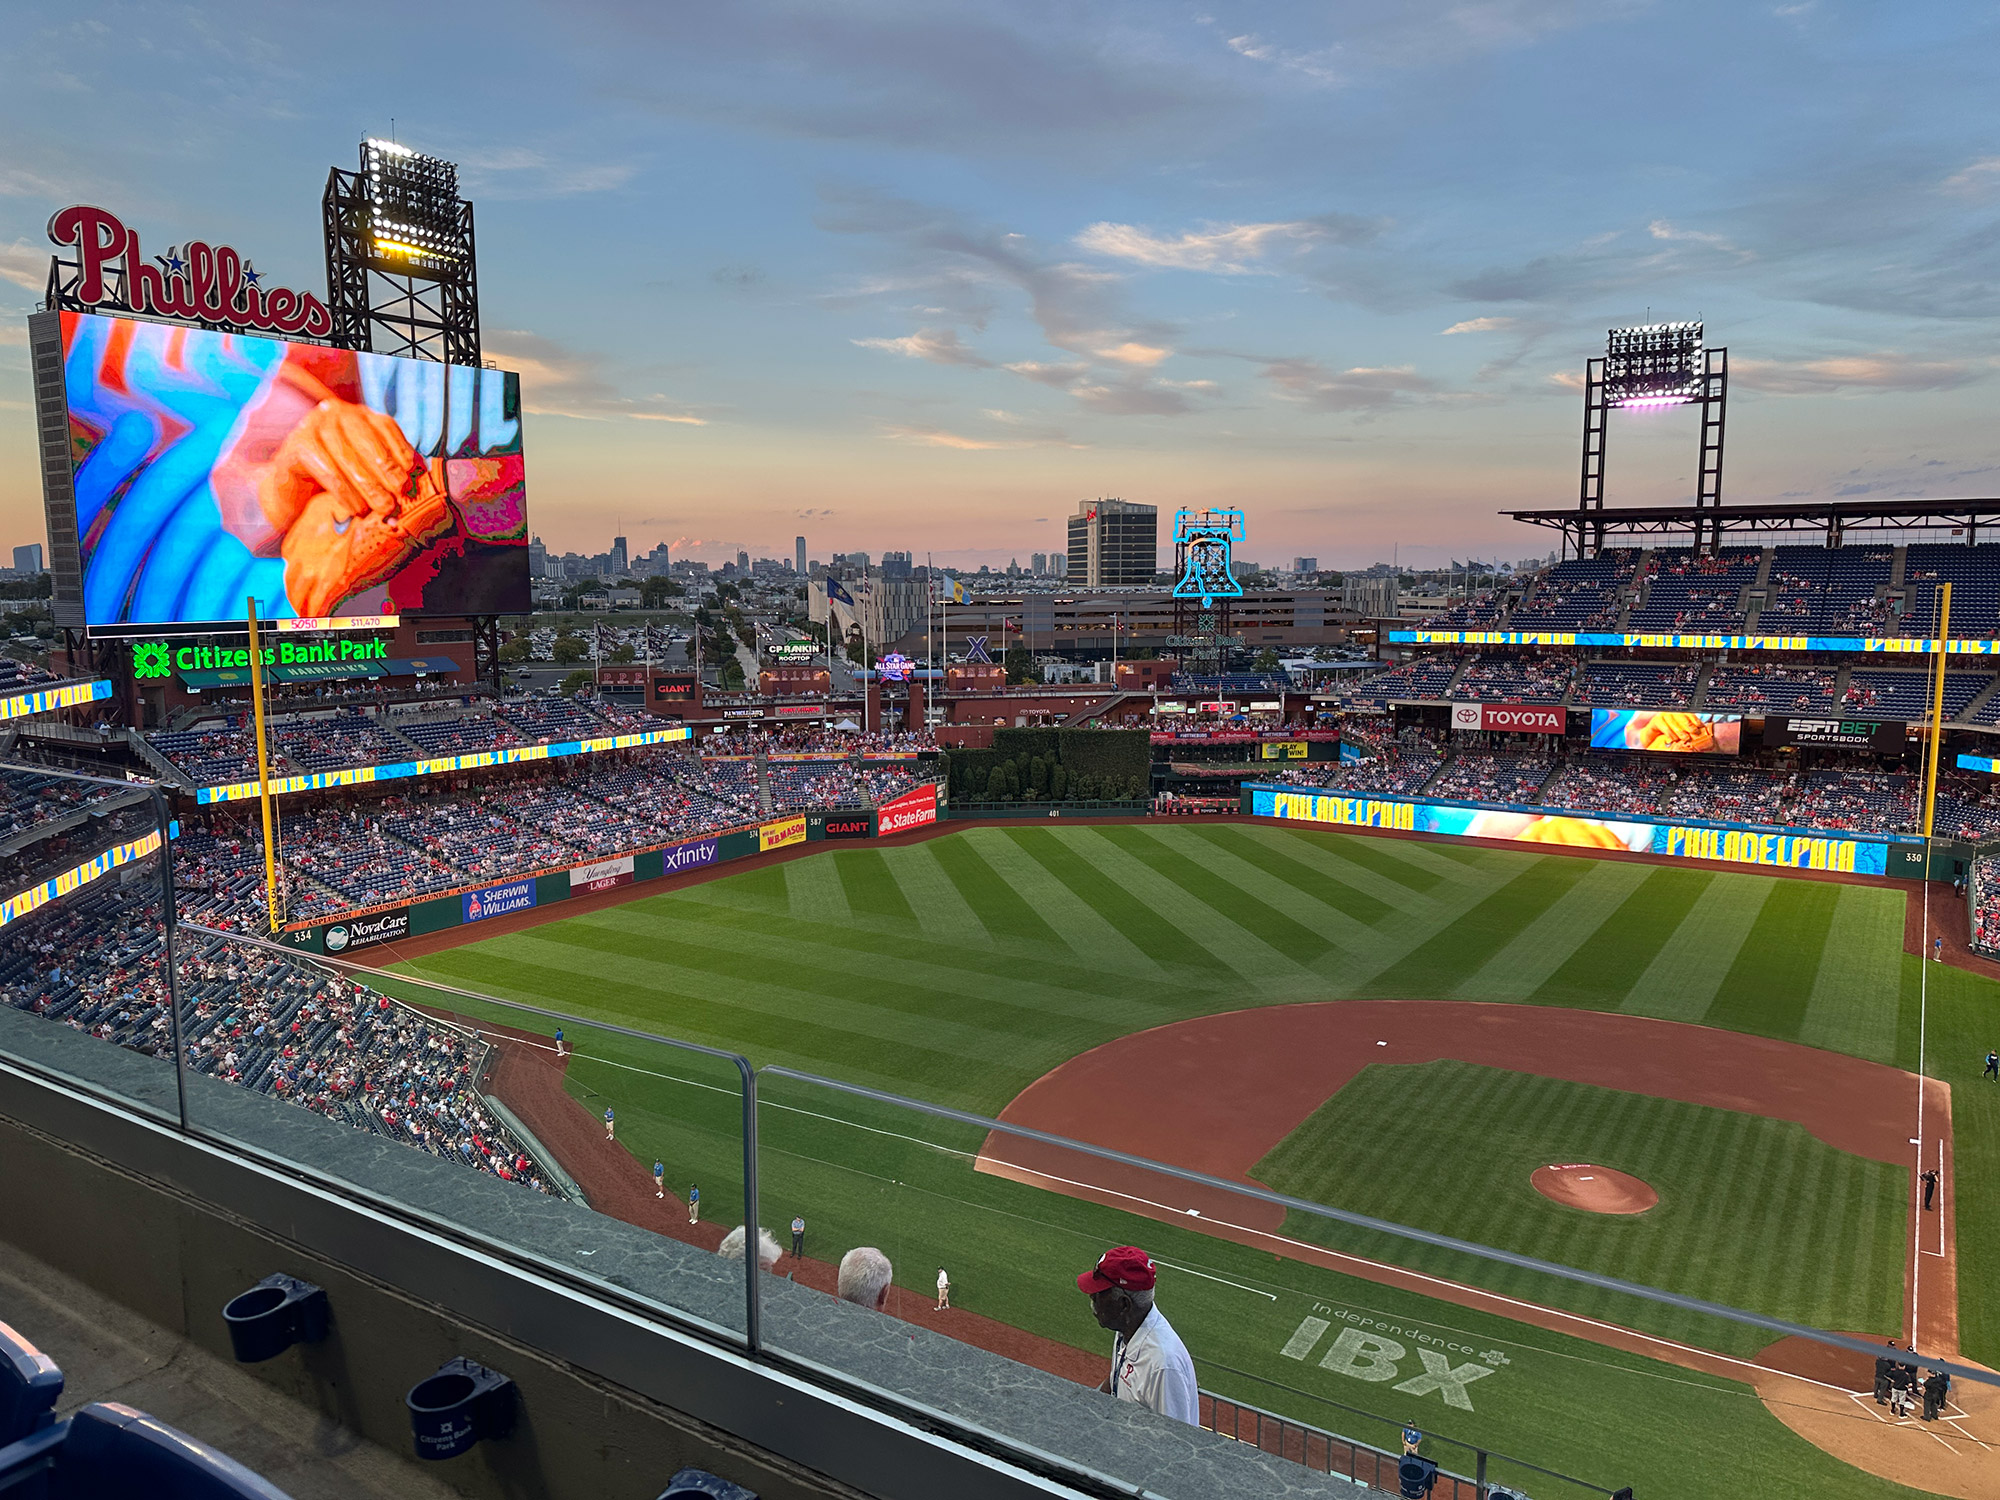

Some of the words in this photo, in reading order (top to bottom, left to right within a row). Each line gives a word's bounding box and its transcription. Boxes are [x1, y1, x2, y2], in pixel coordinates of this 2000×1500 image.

[48, 204, 332, 337] Phillies
[1165, 634, 1214, 647] Citizens
[1215, 634, 1246, 646] Bank
[176, 645, 276, 670] Citizens
[280, 639, 337, 664] Bank
[340, 637, 387, 660] Park
[768, 645, 783, 653] CP
[1192, 647, 1220, 659] Park
[287, 666, 331, 676] HARRY
[658, 684, 691, 693] GIANT
[1486, 710, 1559, 727] TOYOTA
[1787, 719, 1840, 733] ESPN
[1840, 721, 1881, 735] BET
[1796, 733, 1869, 743] SPORTSBOOK
[1274, 793, 1414, 830] PHILADELPHIA
[810, 818, 822, 826] 387
[826, 822, 869, 833] GIANT
[666, 843, 716, 869] xfinity
[1666, 826, 1856, 873] PHILADELPHIA
[1906, 852, 1922, 862] 330
[500, 871, 537, 885] ASPLUNDH
[590, 878, 616, 891] LAGER
[456, 880, 494, 894] ASPLUNDH
[483, 884, 529, 903] SHERWIN
[409, 890, 450, 904] ASPLUNDH
[360, 901, 402, 916] ASPLUNDH
[307, 912, 352, 928] ASPLUNDH
[350, 914, 408, 938] NovaCare
[294, 930, 312, 943] 334
[351, 928, 406, 946] REHABILITATION
[1312, 1302, 1474, 1355] Independence
[1280, 1315, 1496, 1412] IBX
[420, 1435, 453, 1444] Citizens
[436, 1441, 456, 1450] Park
